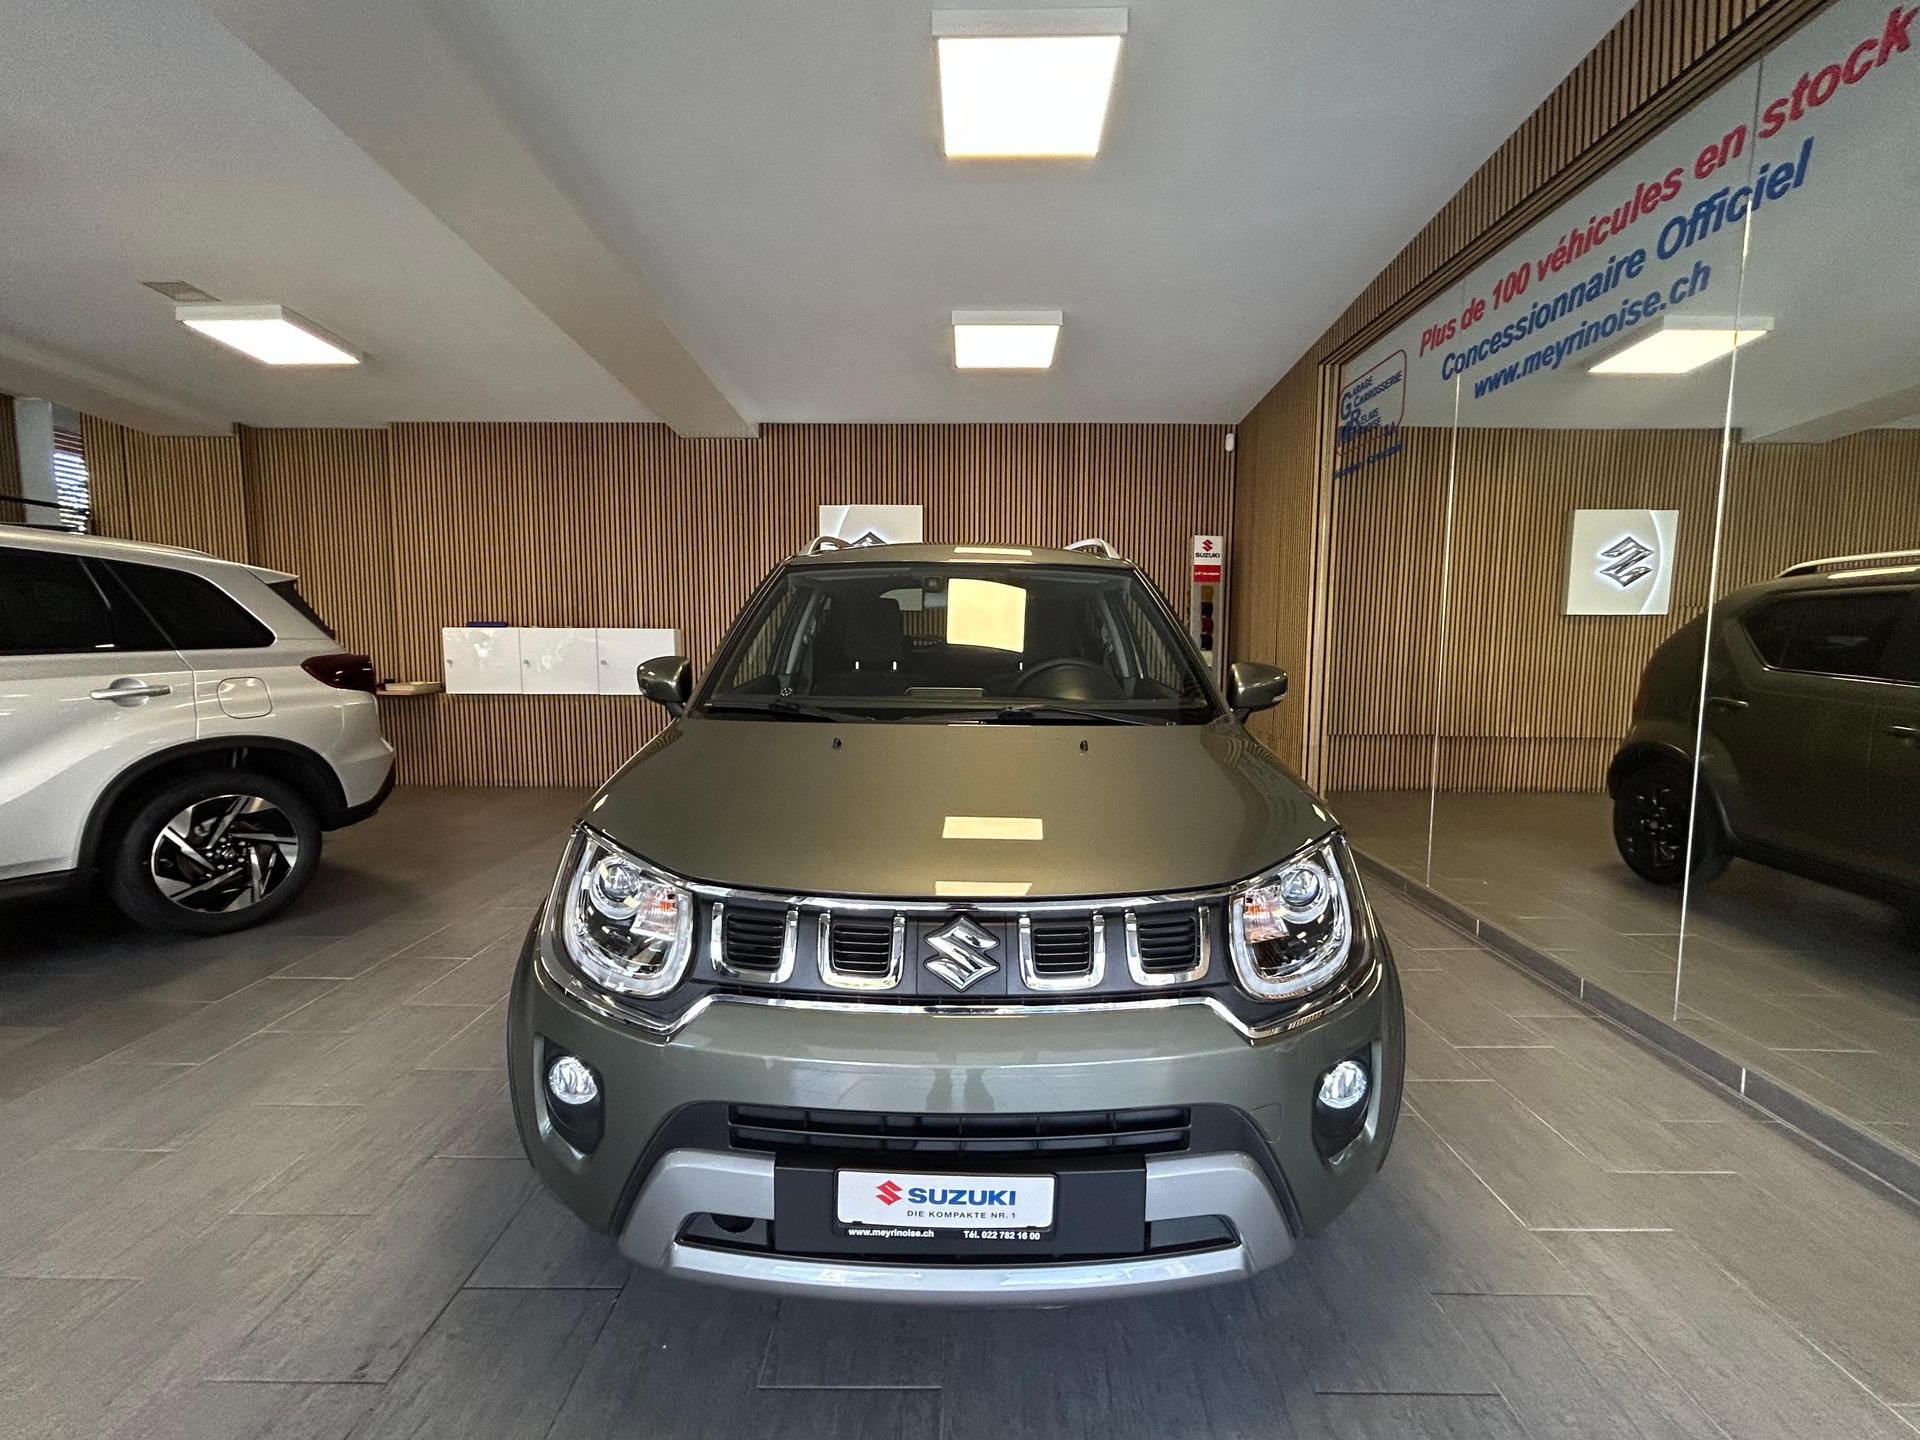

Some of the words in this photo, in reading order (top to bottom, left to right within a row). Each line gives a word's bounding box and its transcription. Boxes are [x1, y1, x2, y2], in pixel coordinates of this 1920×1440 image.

[1419, 323, 1457, 358] Plus
[1460, 297, 1486, 330] de
[1492, 262, 1531, 310] 100
[1537, 167, 1684, 281] véhicules
[1694, 124, 1747, 179] en
[1758, 6, 1920, 139] stock
[1441, 248, 1646, 381] Concessionnaire
[1656, 135, 1815, 260] Officiel
[1473, 260, 1711, 399] www.meyrinoise.ch
[908, 1187, 1016, 1206] SUZUKI
[907, 1210, 924, 1218] DIE
[928, 1210, 987, 1219] KOMPAKTE
[991, 1211, 1009, 1219] NR.
[1011, 1211, 1016, 1219] 1
[848, 1228, 934, 1239] www.meyrinoise.ch
[963, 1230, 980, 1239] Tél.
[981, 1230, 998, 1240] 022
[999, 1231, 1016, 1240] 782
[1029, 1232, 1041, 1240] 00
